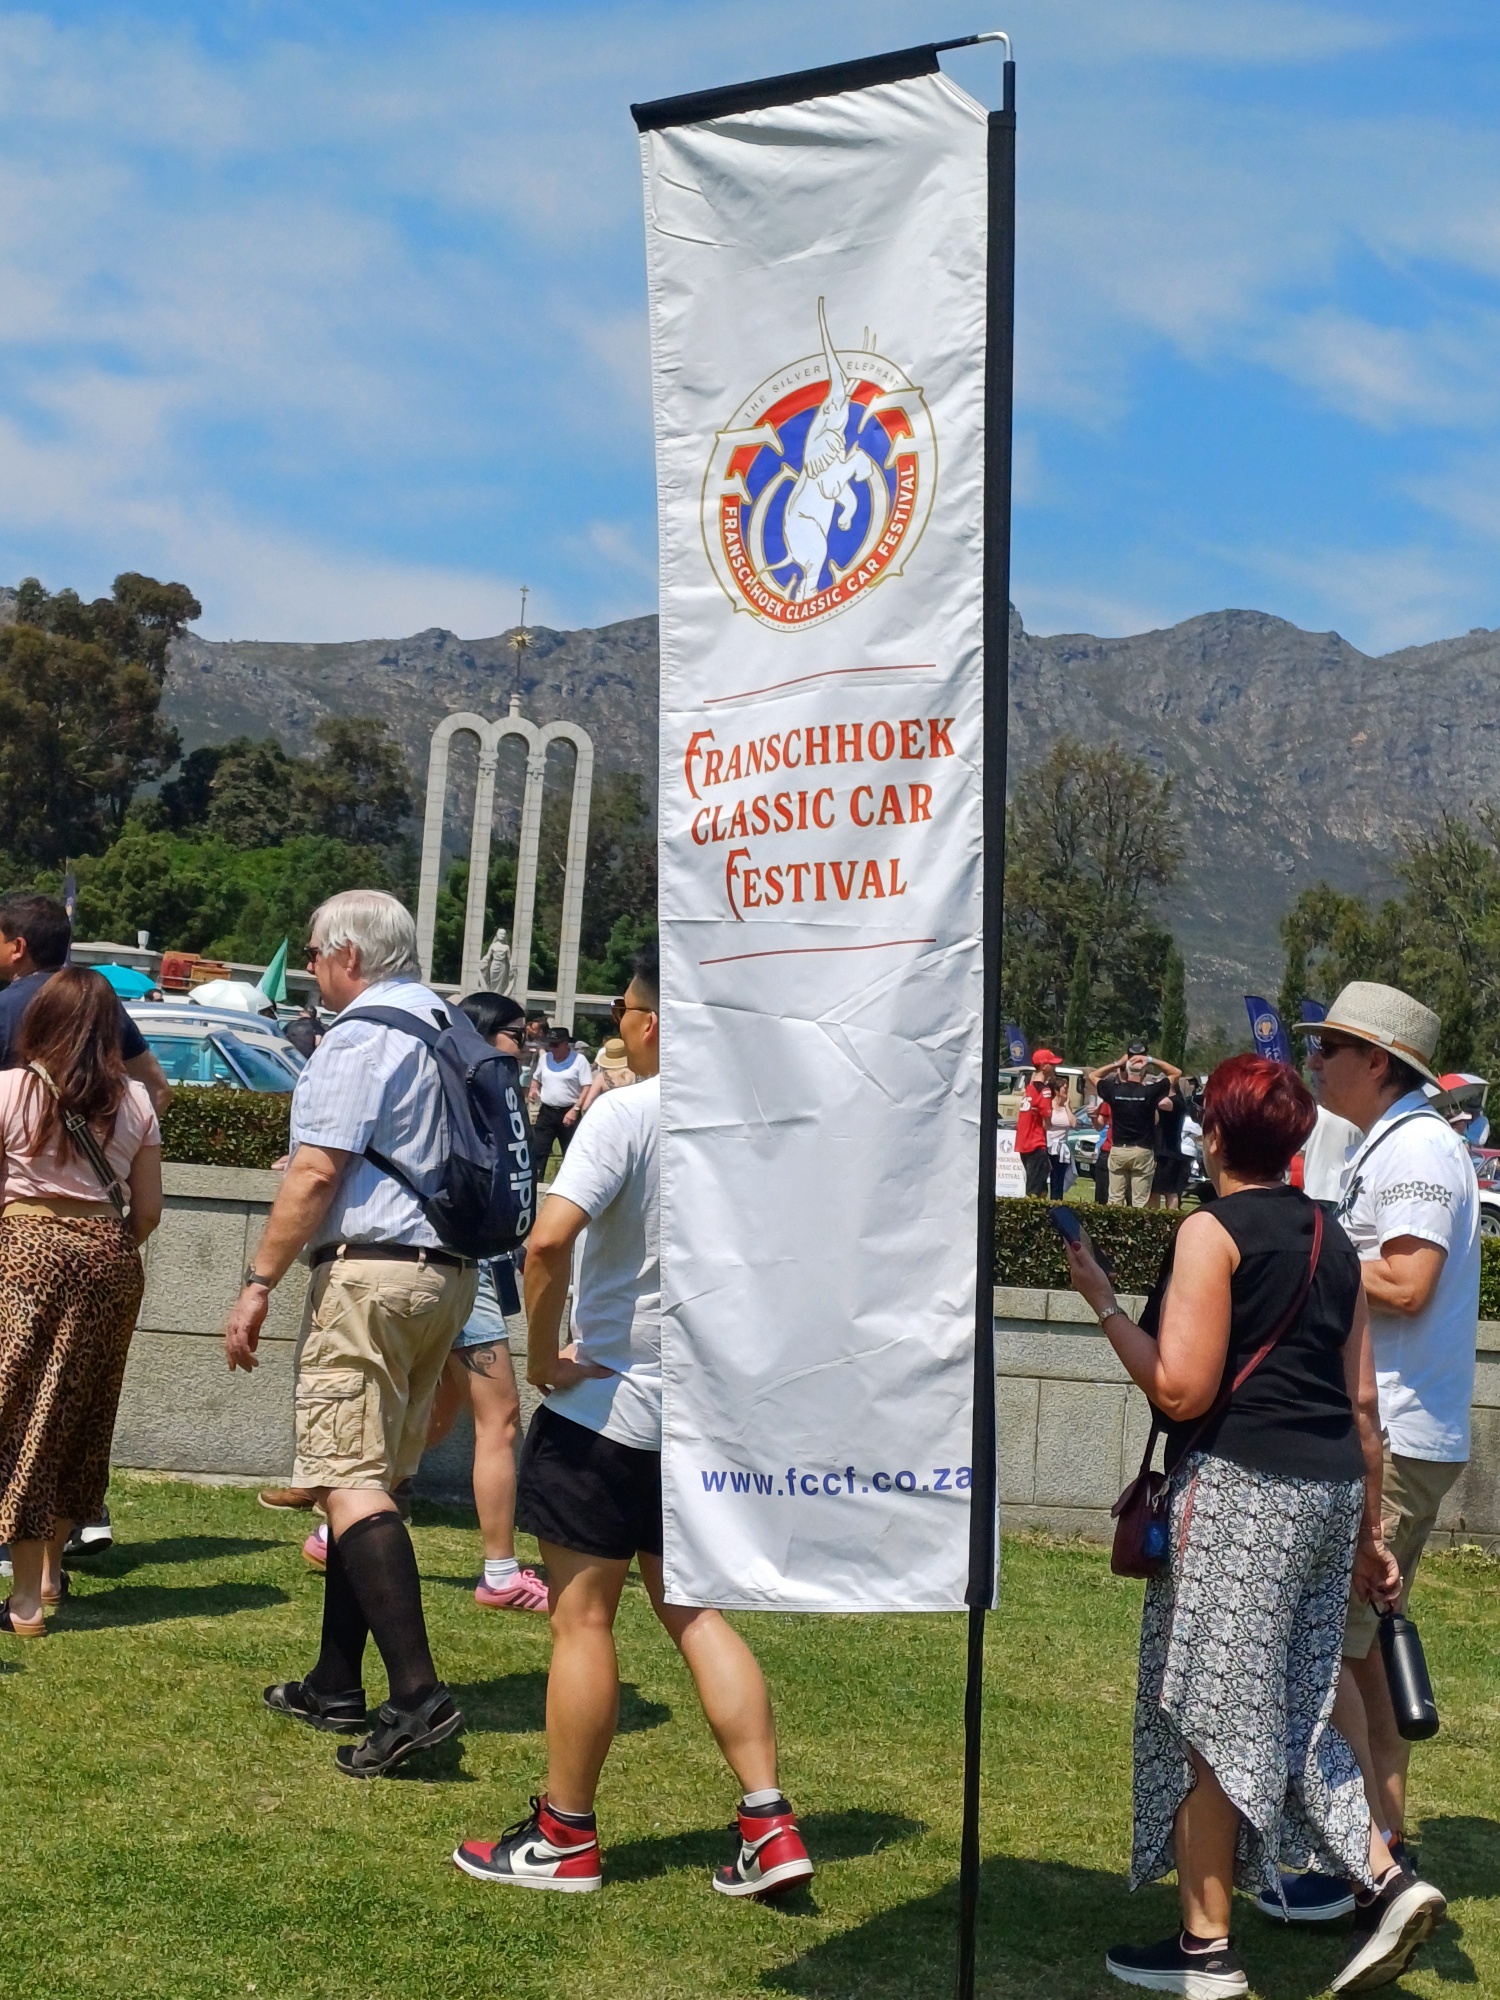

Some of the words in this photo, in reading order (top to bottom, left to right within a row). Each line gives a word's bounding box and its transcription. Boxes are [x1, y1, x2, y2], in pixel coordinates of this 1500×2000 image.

[744, 394, 767, 420] THE
[772, 365, 822, 394] SILVER
[846, 361, 900, 389] ELEPHANT
[724, 505, 785, 618] FRANSCHHOEK
[785, 588, 843, 620] CLASSIC
[846, 558, 881, 592] CAR
[877, 464, 915, 558] FESTIVAL
[684, 717, 956, 801] FRANSCHHOEK
[690, 786, 835, 846] CLASSIC
[850, 783, 933, 828] CAR
[726, 846, 908, 923] FESTIVAL
[504, 1086, 533, 1237] adidas
[700, 1466, 973, 1497] www.fccf.co.za
